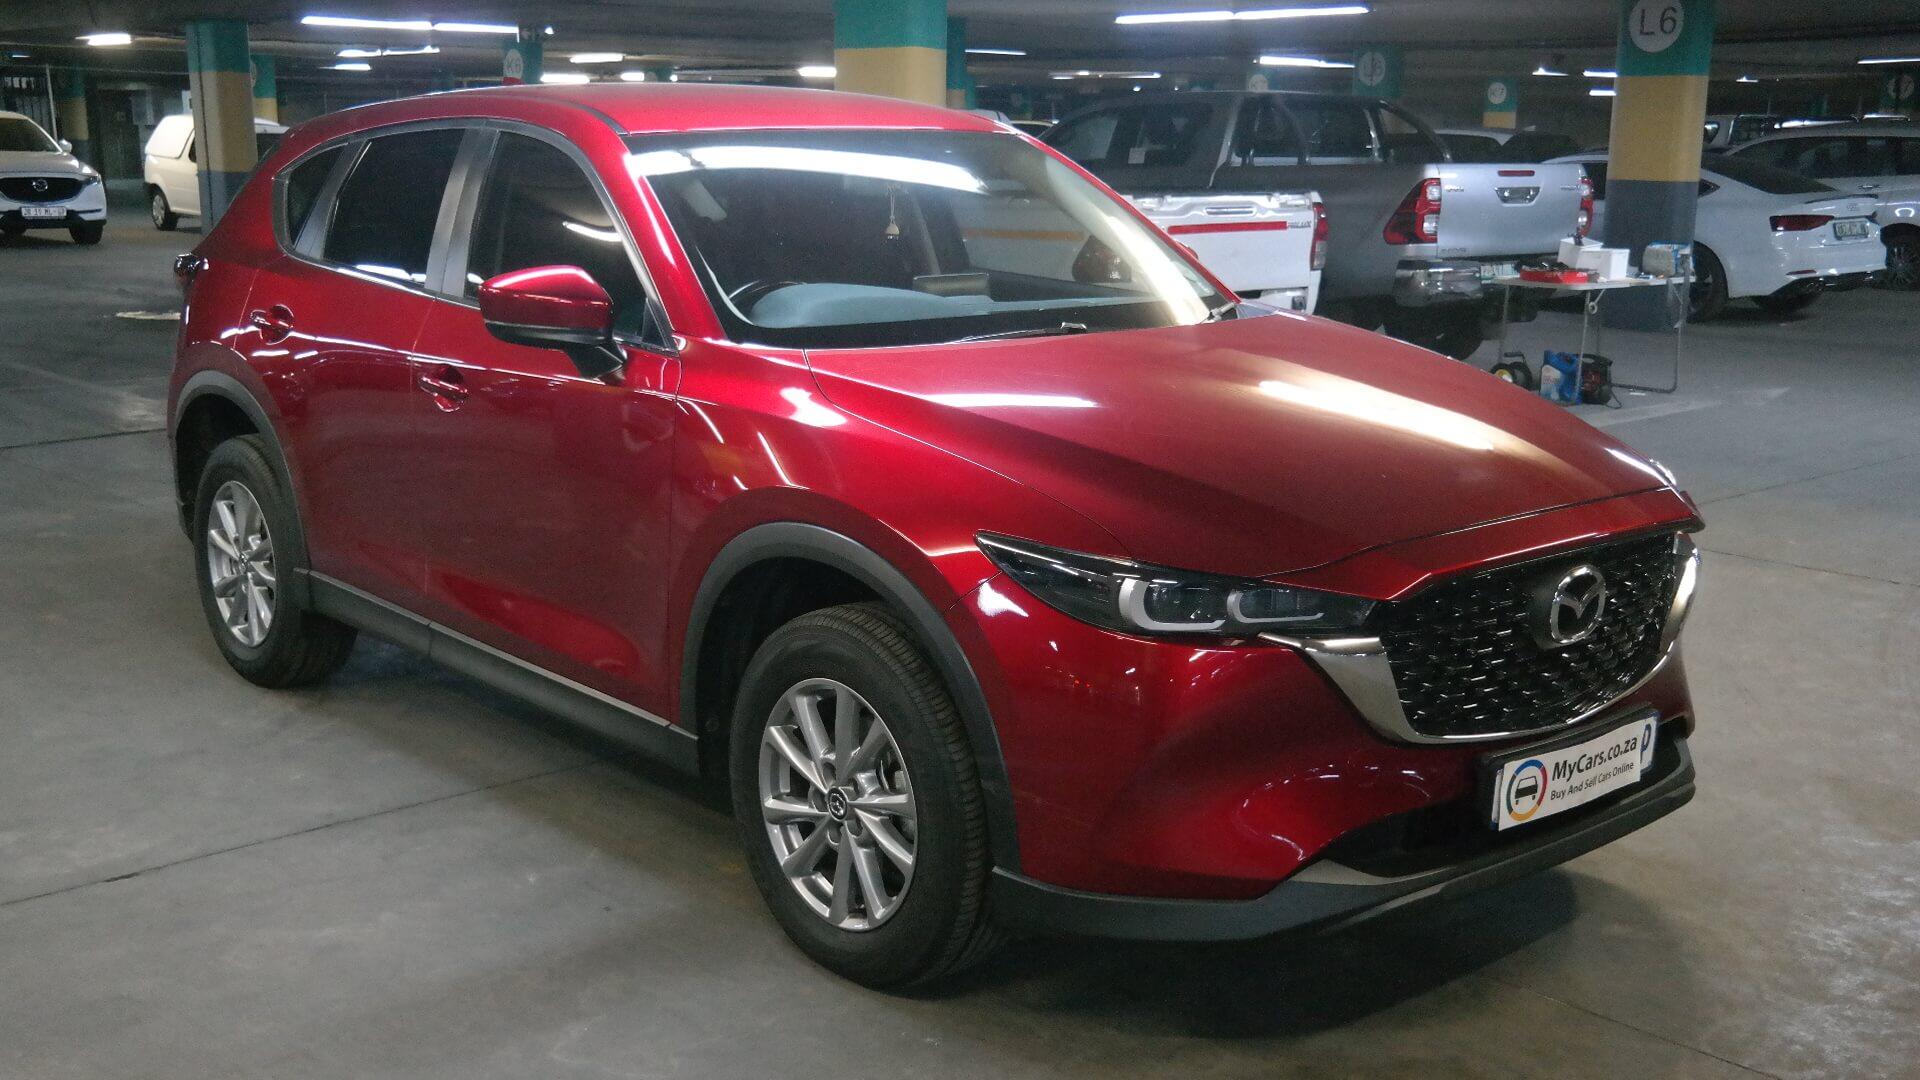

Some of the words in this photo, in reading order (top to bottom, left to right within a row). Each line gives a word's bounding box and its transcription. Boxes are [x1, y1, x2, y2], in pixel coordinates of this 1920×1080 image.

[1640, 7, 1677, 35] L6
[1552, 737, 1638, 782] MyCars.co.za
[1550, 789, 1566, 800] Buy
[1567, 782, 1583, 796] And
[1584, 774, 1597, 789] Sell
[1598, 771, 1612, 783] Cars
[1612, 762, 1634, 777] Online
